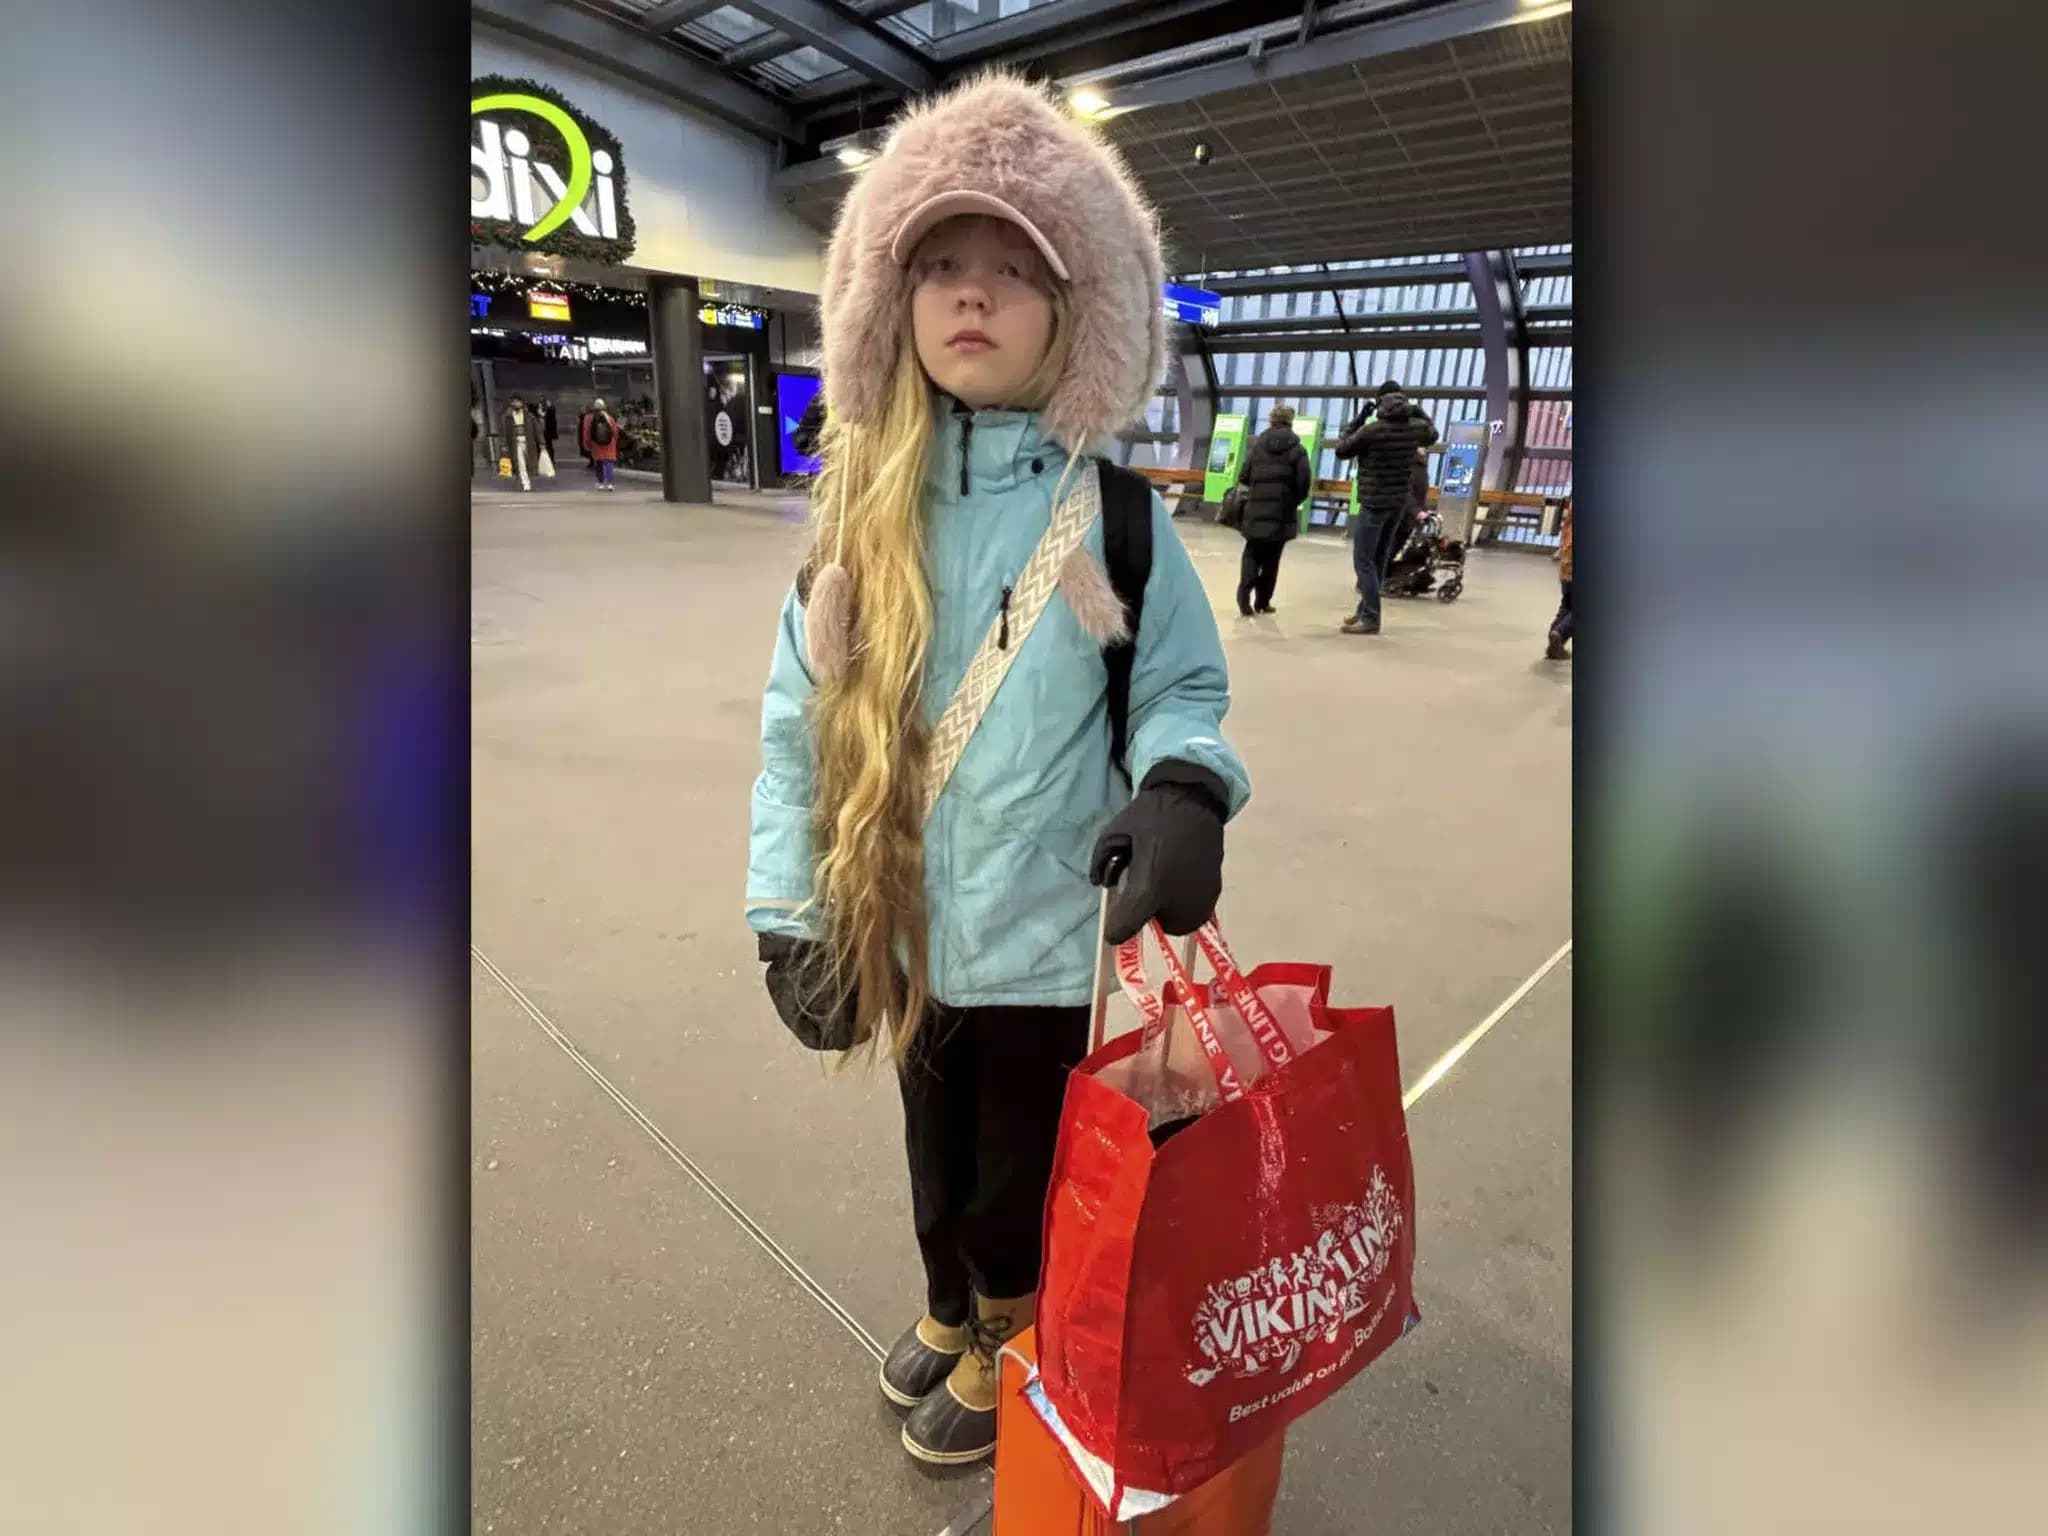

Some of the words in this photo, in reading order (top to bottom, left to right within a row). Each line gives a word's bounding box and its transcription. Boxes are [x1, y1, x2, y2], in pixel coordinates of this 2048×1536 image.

[471, 119, 618, 240] dixi
[1185, 997, 1222, 1058] LINE
[1220, 1066, 1243, 1102] VI
[1236, 986, 1279, 1044] LINE
[1209, 1280, 1339, 1352] VIKIN
[1332, 1225, 1382, 1282] LIN
[1229, 1396, 1268, 1423] Best
[1271, 1372, 1314, 1404] value
[1316, 1363, 1337, 1379] on
